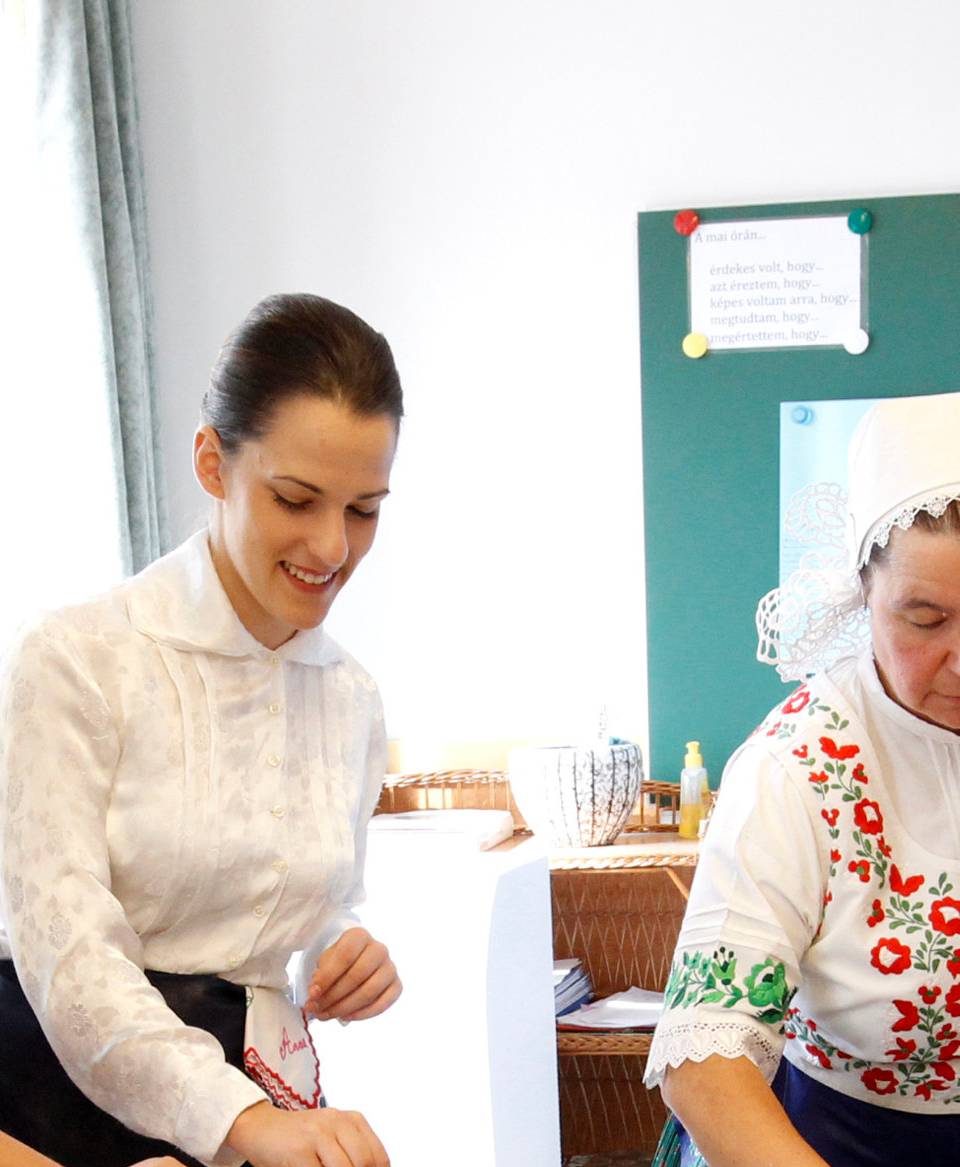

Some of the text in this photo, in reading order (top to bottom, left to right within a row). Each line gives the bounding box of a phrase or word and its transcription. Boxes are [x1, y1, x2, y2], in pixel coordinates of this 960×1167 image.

[695, 231, 703, 243] A
[706, 232, 727, 242] mai
[710, 263, 755, 275] érdekes
[759, 261, 783, 273] volt,
[710, 281, 727, 292] azt
[730, 280, 780, 291] éreztem,
[710, 297, 742, 310] képes
[746, 294, 786, 306] voltam
[790, 296, 817, 305] arra,
[711, 314, 779, 327] megtudtam,
[710, 331, 787, 344] megértettem,
